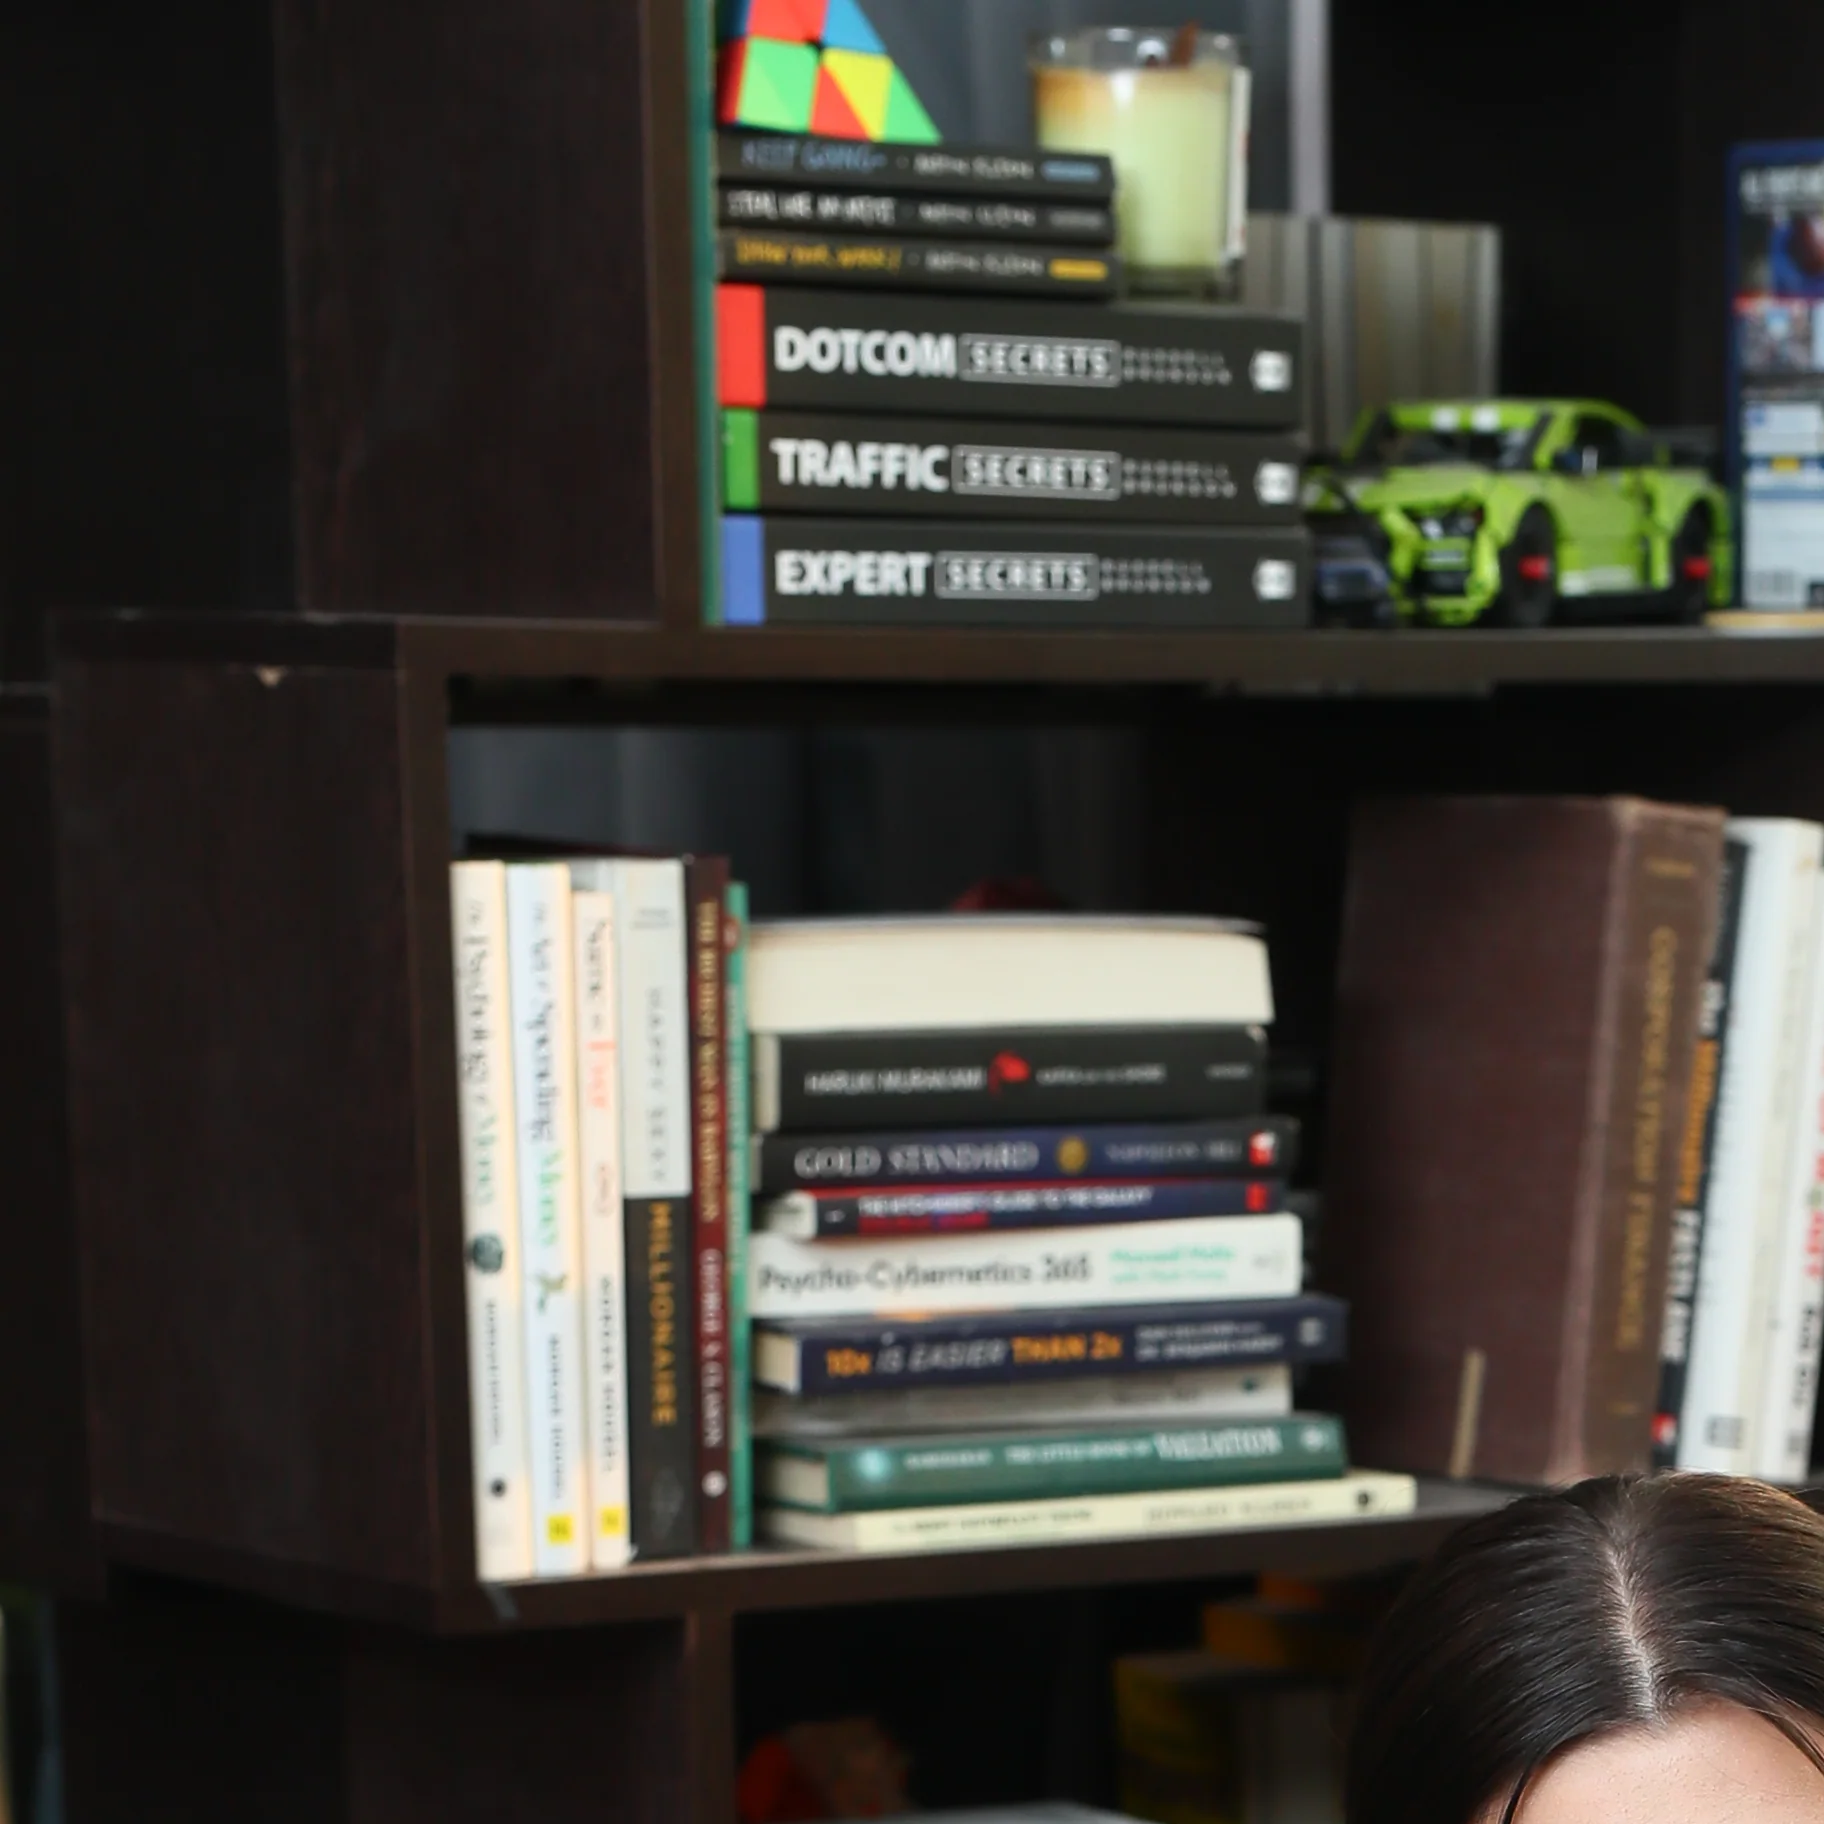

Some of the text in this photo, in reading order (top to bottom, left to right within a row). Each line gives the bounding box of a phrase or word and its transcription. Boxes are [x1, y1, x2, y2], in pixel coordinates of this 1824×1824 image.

[774, 327, 957, 376] DOTCOM
[968, 341, 1110, 378] SECRETS
[770, 439, 949, 491] TRAFFIC
[963, 453, 1109, 488] SECRETS
[775, 550, 932, 595] EXPERT
[942, 557, 1088, 593] SECRETS
[794, 1139, 1040, 1178] GOLD STANDARD
[758, 1253, 1092, 1297] Psycho-Cybernetics 365
[649, 1201, 677, 1428] MILLIONAIRE
[876, 1345, 903, 1372] IS
[906, 1338, 1008, 1372] EASIER
[1010, 1334, 1085, 1366] THAN
